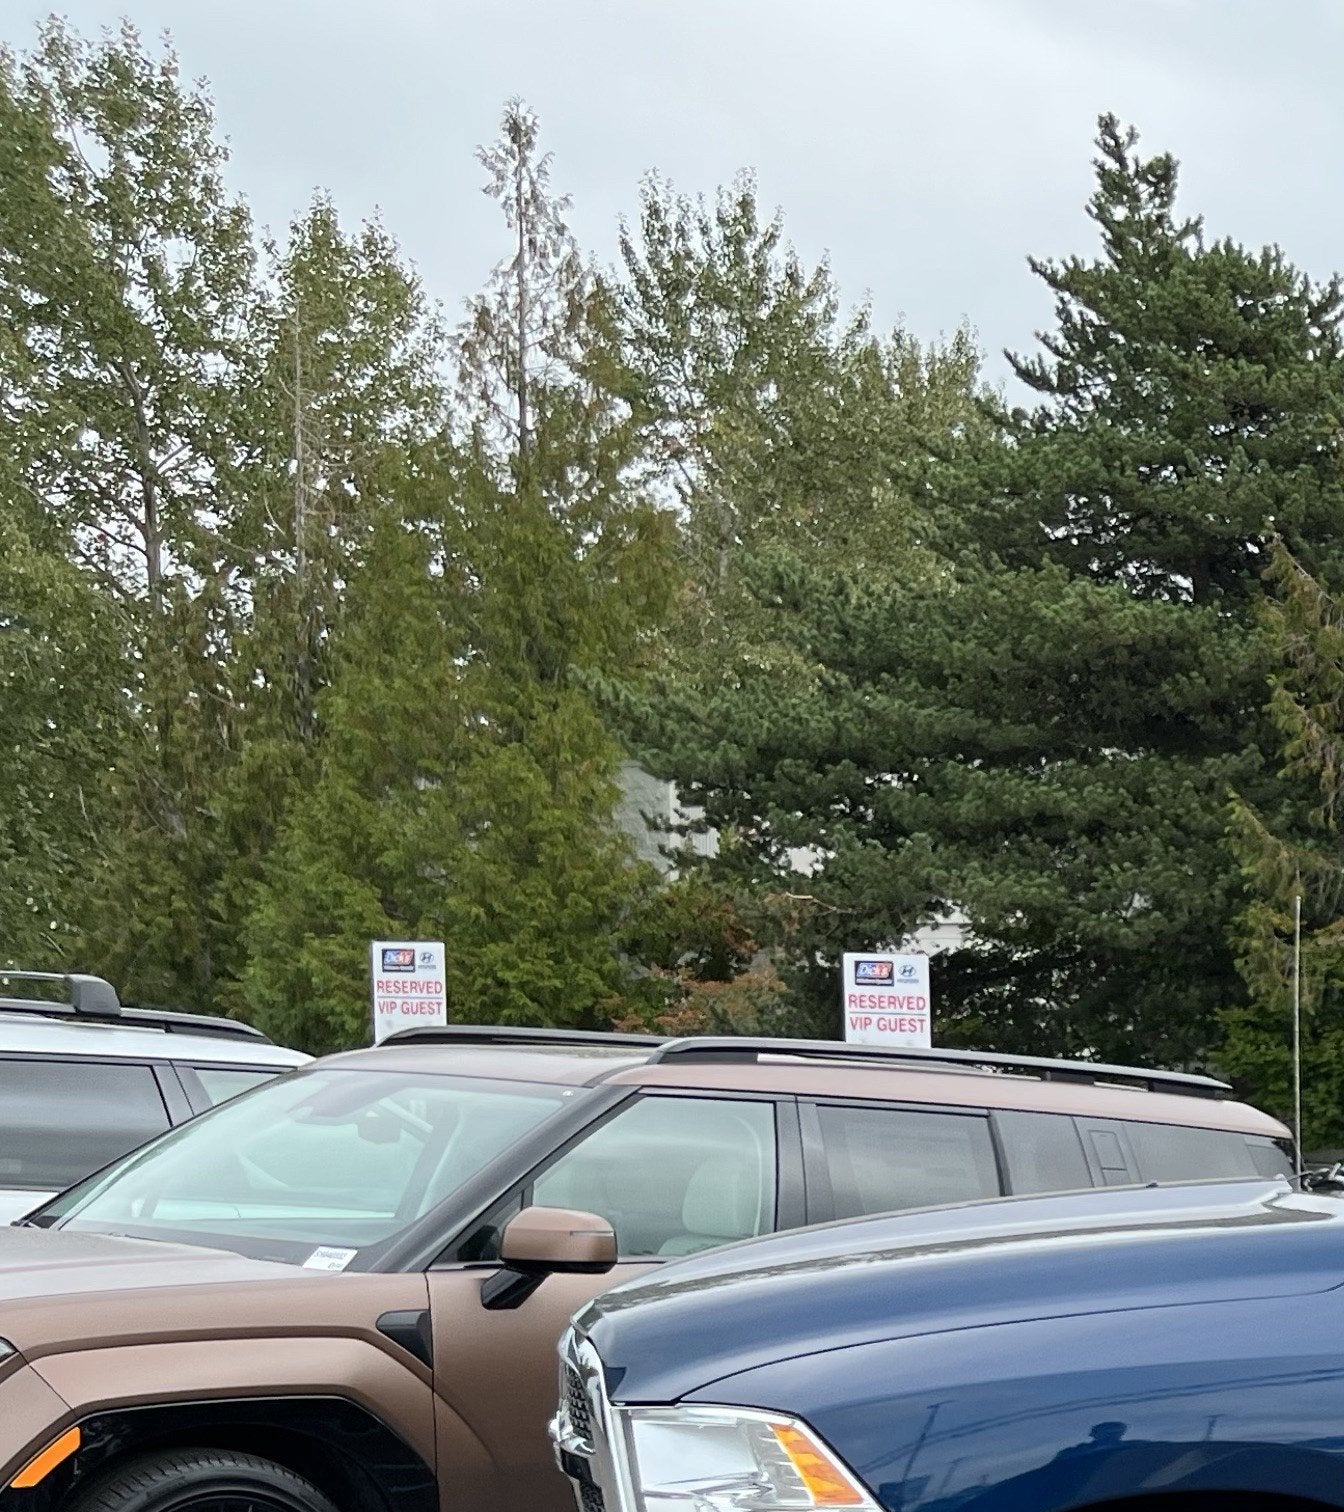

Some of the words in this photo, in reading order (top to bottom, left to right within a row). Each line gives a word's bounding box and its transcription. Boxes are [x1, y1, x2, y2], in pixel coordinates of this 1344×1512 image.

[376, 980, 443, 995] RESERVED
[378, 1001, 397, 1014] VIP
[401, 1001, 442, 1015] GUEST
[848, 994, 926, 1011] RESERVED
[850, 1016, 872, 1031] VIP
[877, 1017, 926, 1034] GUEST
